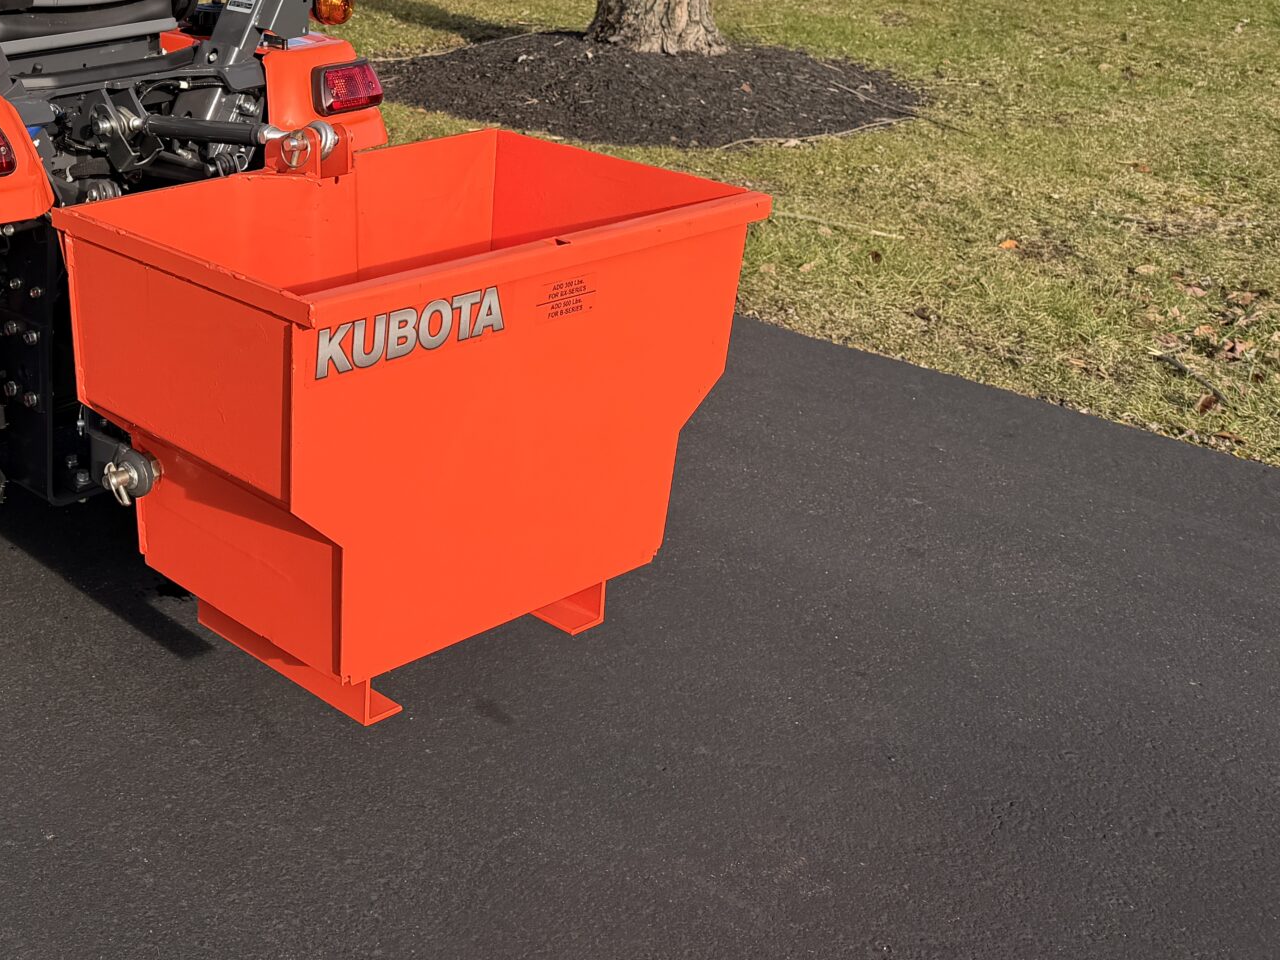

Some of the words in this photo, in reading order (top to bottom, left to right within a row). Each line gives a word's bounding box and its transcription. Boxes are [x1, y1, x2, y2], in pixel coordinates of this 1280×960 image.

[548, 291, 560, 300] FOR
[547, 310, 559, 319] FOR
[315, 286, 505, 380] KUBOTA
